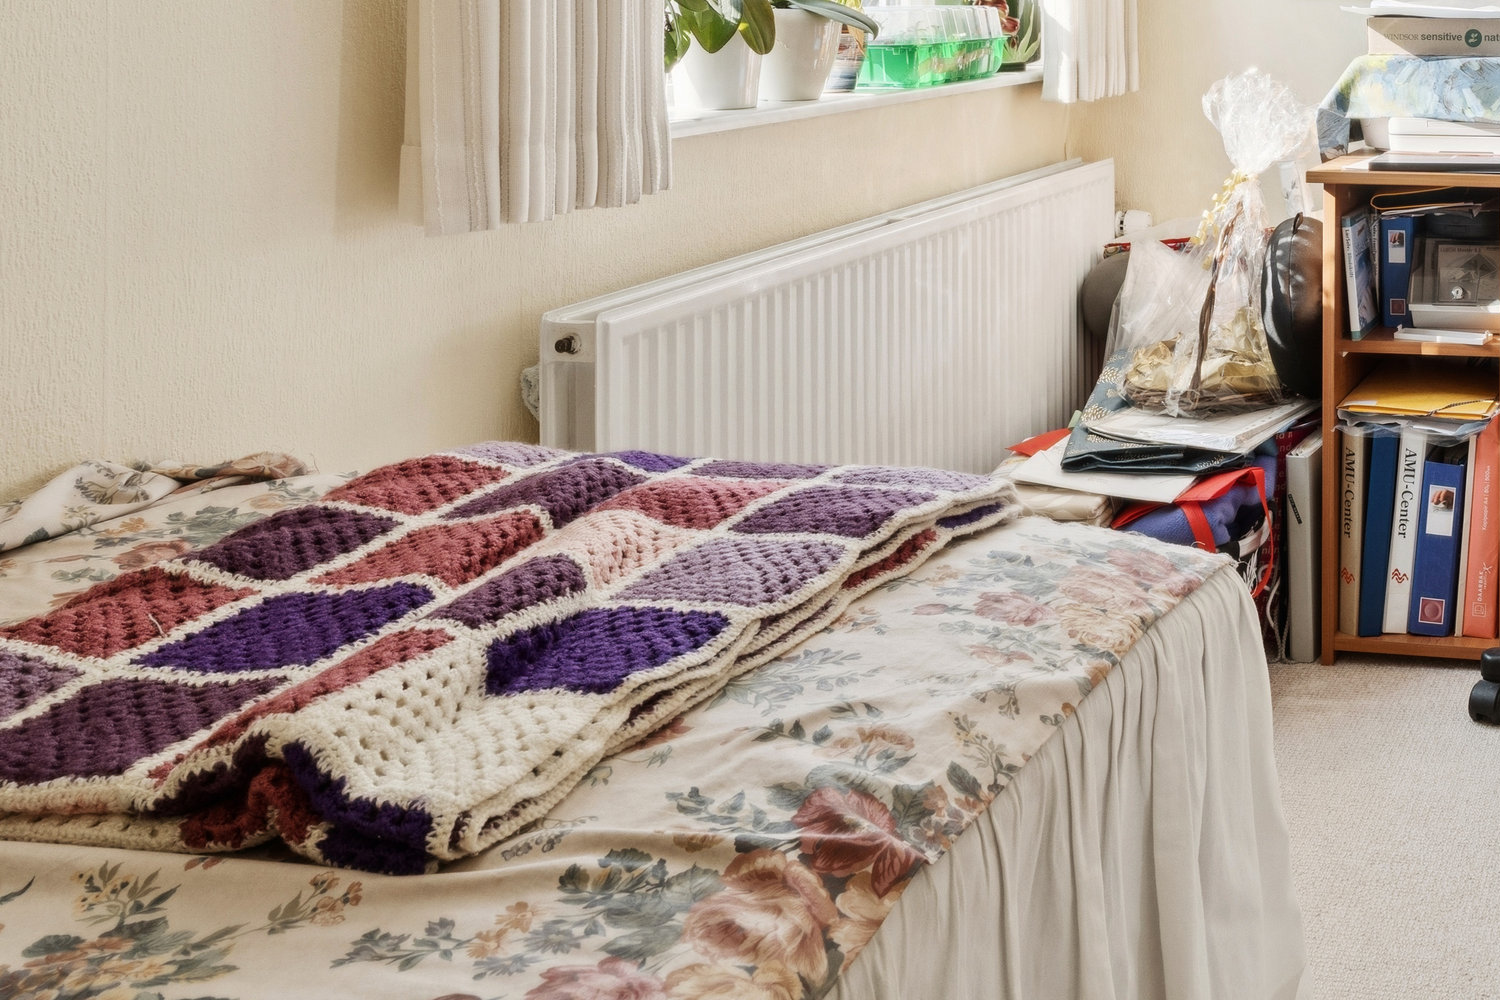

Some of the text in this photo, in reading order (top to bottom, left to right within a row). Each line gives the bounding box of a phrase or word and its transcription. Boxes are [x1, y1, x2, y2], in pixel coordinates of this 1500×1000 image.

[1420, 32, 1462, 41] sensitive
[1343, 447, 1356, 539] AMU-Center
[1398, 447, 1417, 539] AMU-Center
